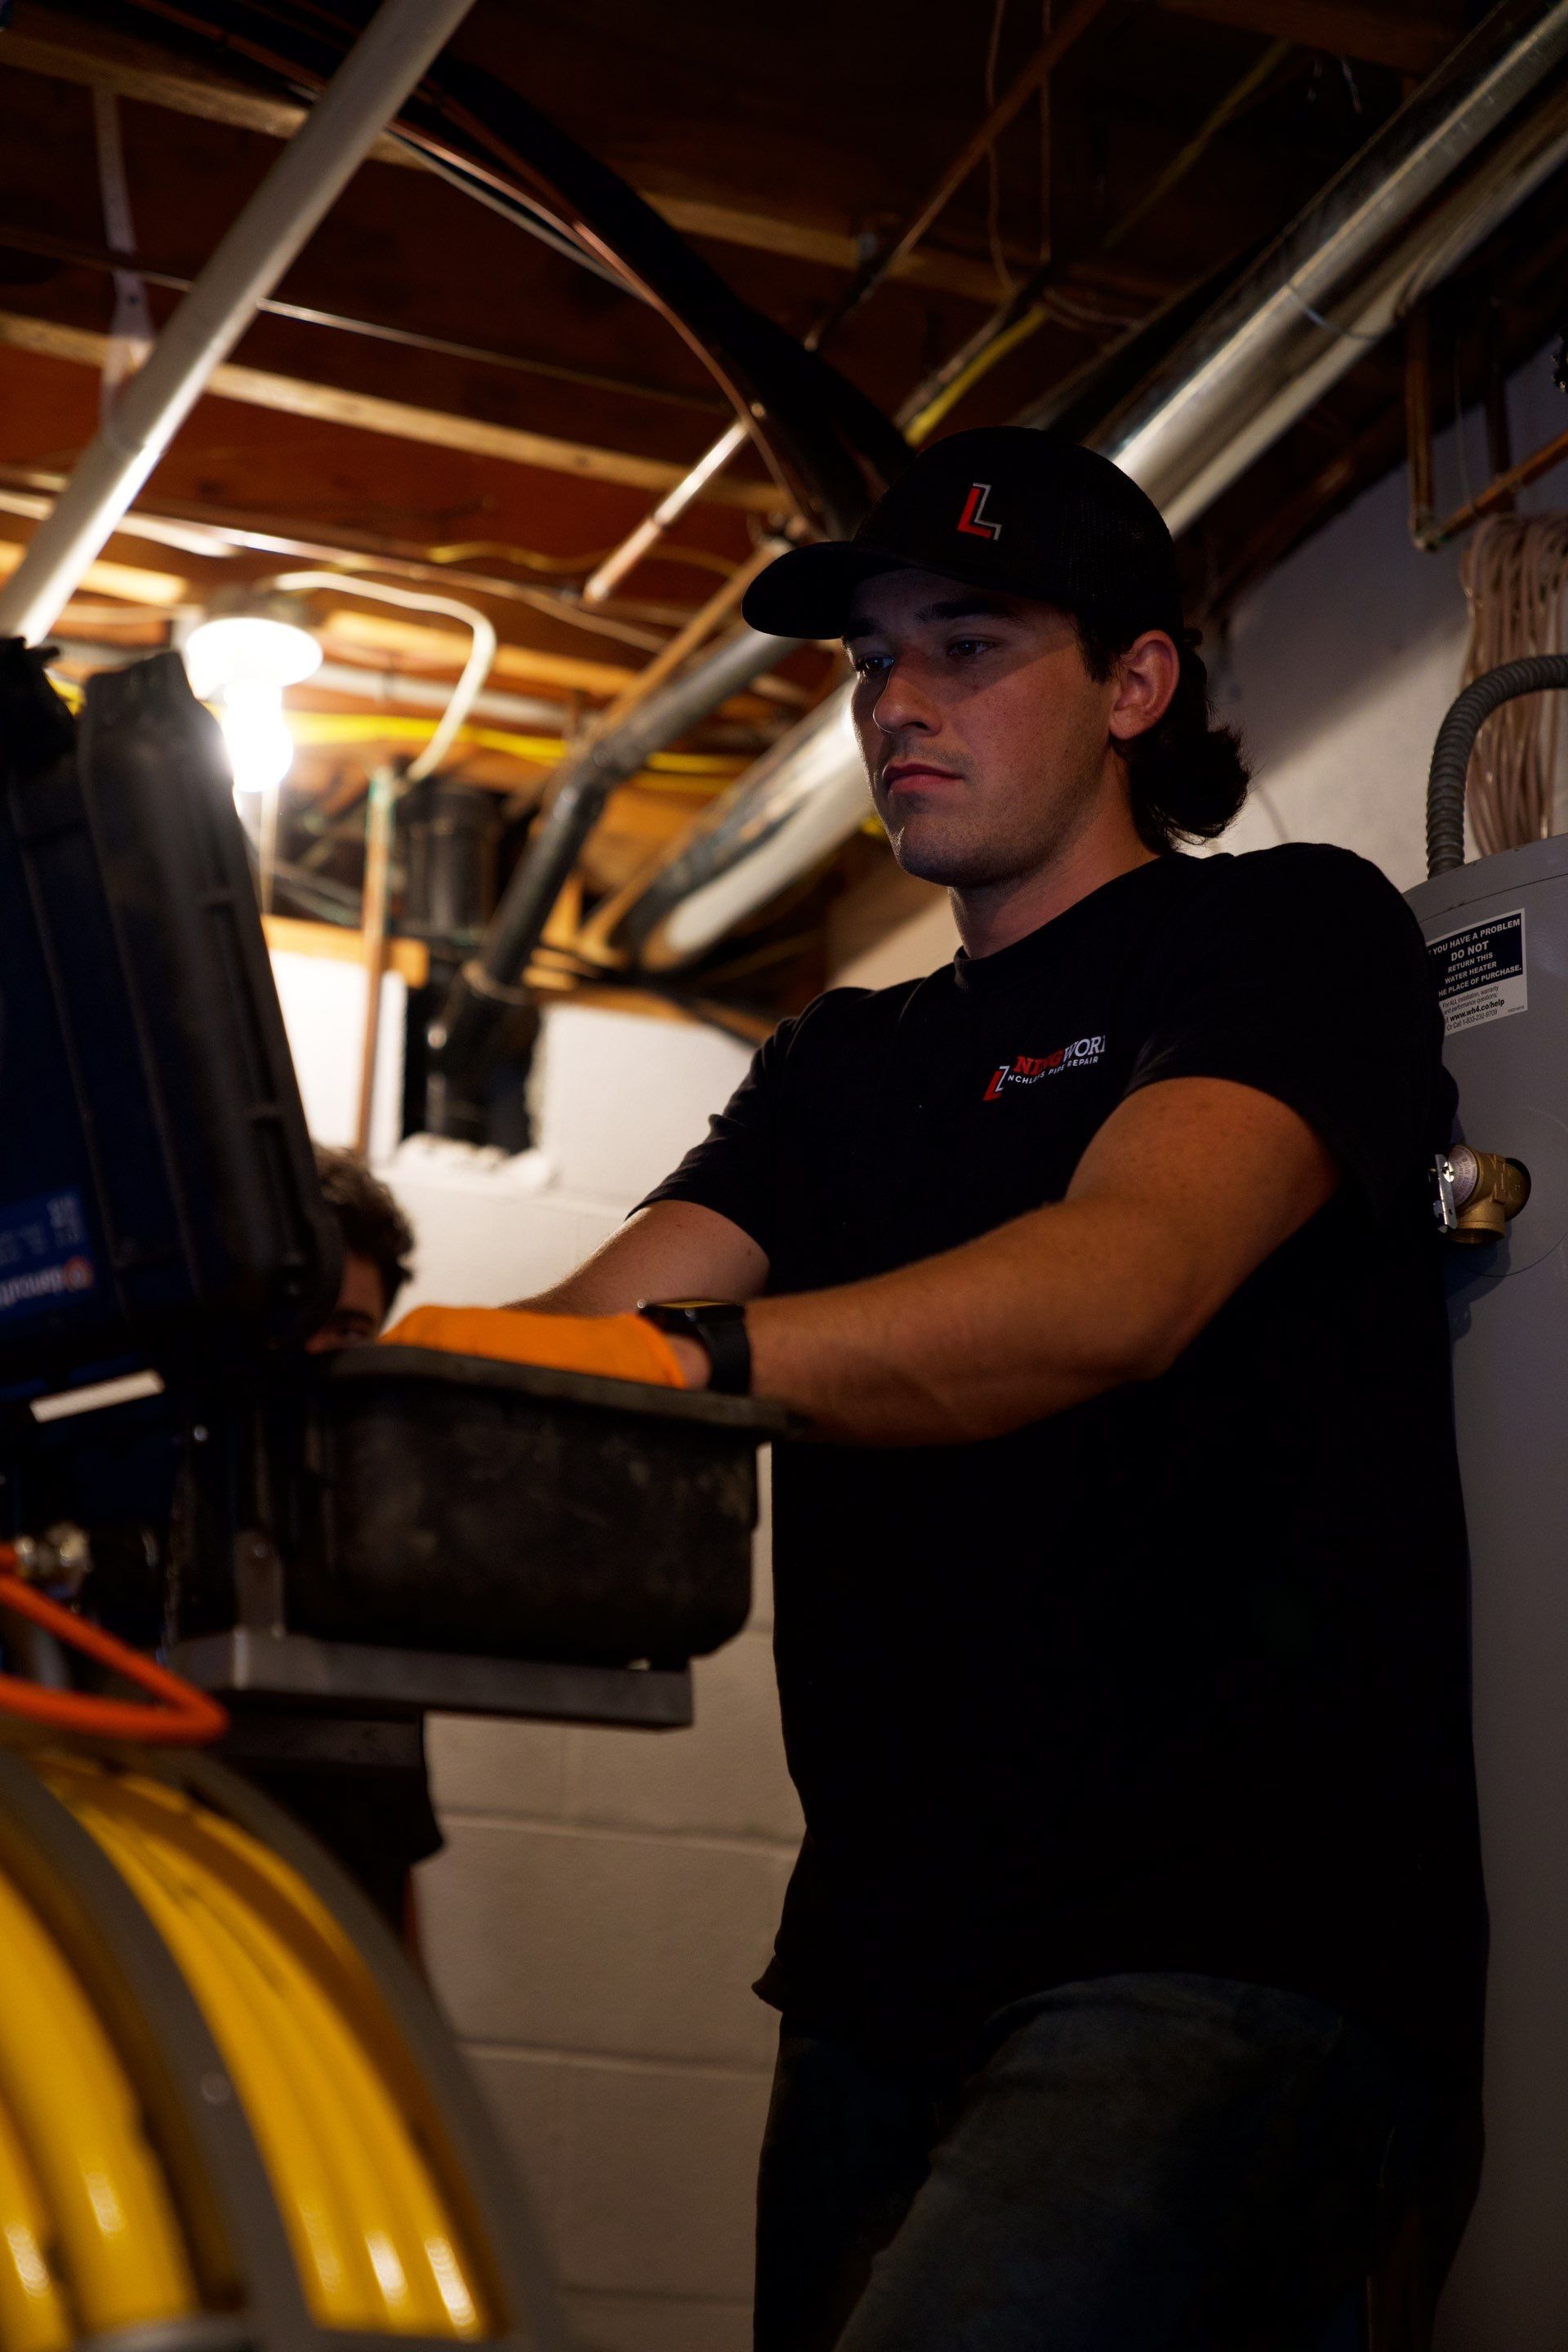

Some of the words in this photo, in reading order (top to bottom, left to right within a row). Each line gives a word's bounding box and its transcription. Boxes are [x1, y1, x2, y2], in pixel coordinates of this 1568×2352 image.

[1432, 943, 1448, 956] YOU
[1450, 933, 1470, 947] HAVE
[1472, 932, 1479, 940] A
[1480, 918, 1521, 938] PROBLEM
[1447, 958, 1475, 973] RETURN
[1477, 951, 1494, 963] THIS
[1450, 948, 1464, 962] DO
[1468, 940, 1490, 956] NOT
[1444, 969, 1468, 985] WATER
[1468, 961, 1497, 975] HEATER
[1447, 981, 1469, 995] PLACE
[1470, 977, 1480, 986] OF
[1481, 964, 1522, 982] PURCHASE.
[1067, 1055, 1099, 1068] REPAIR
